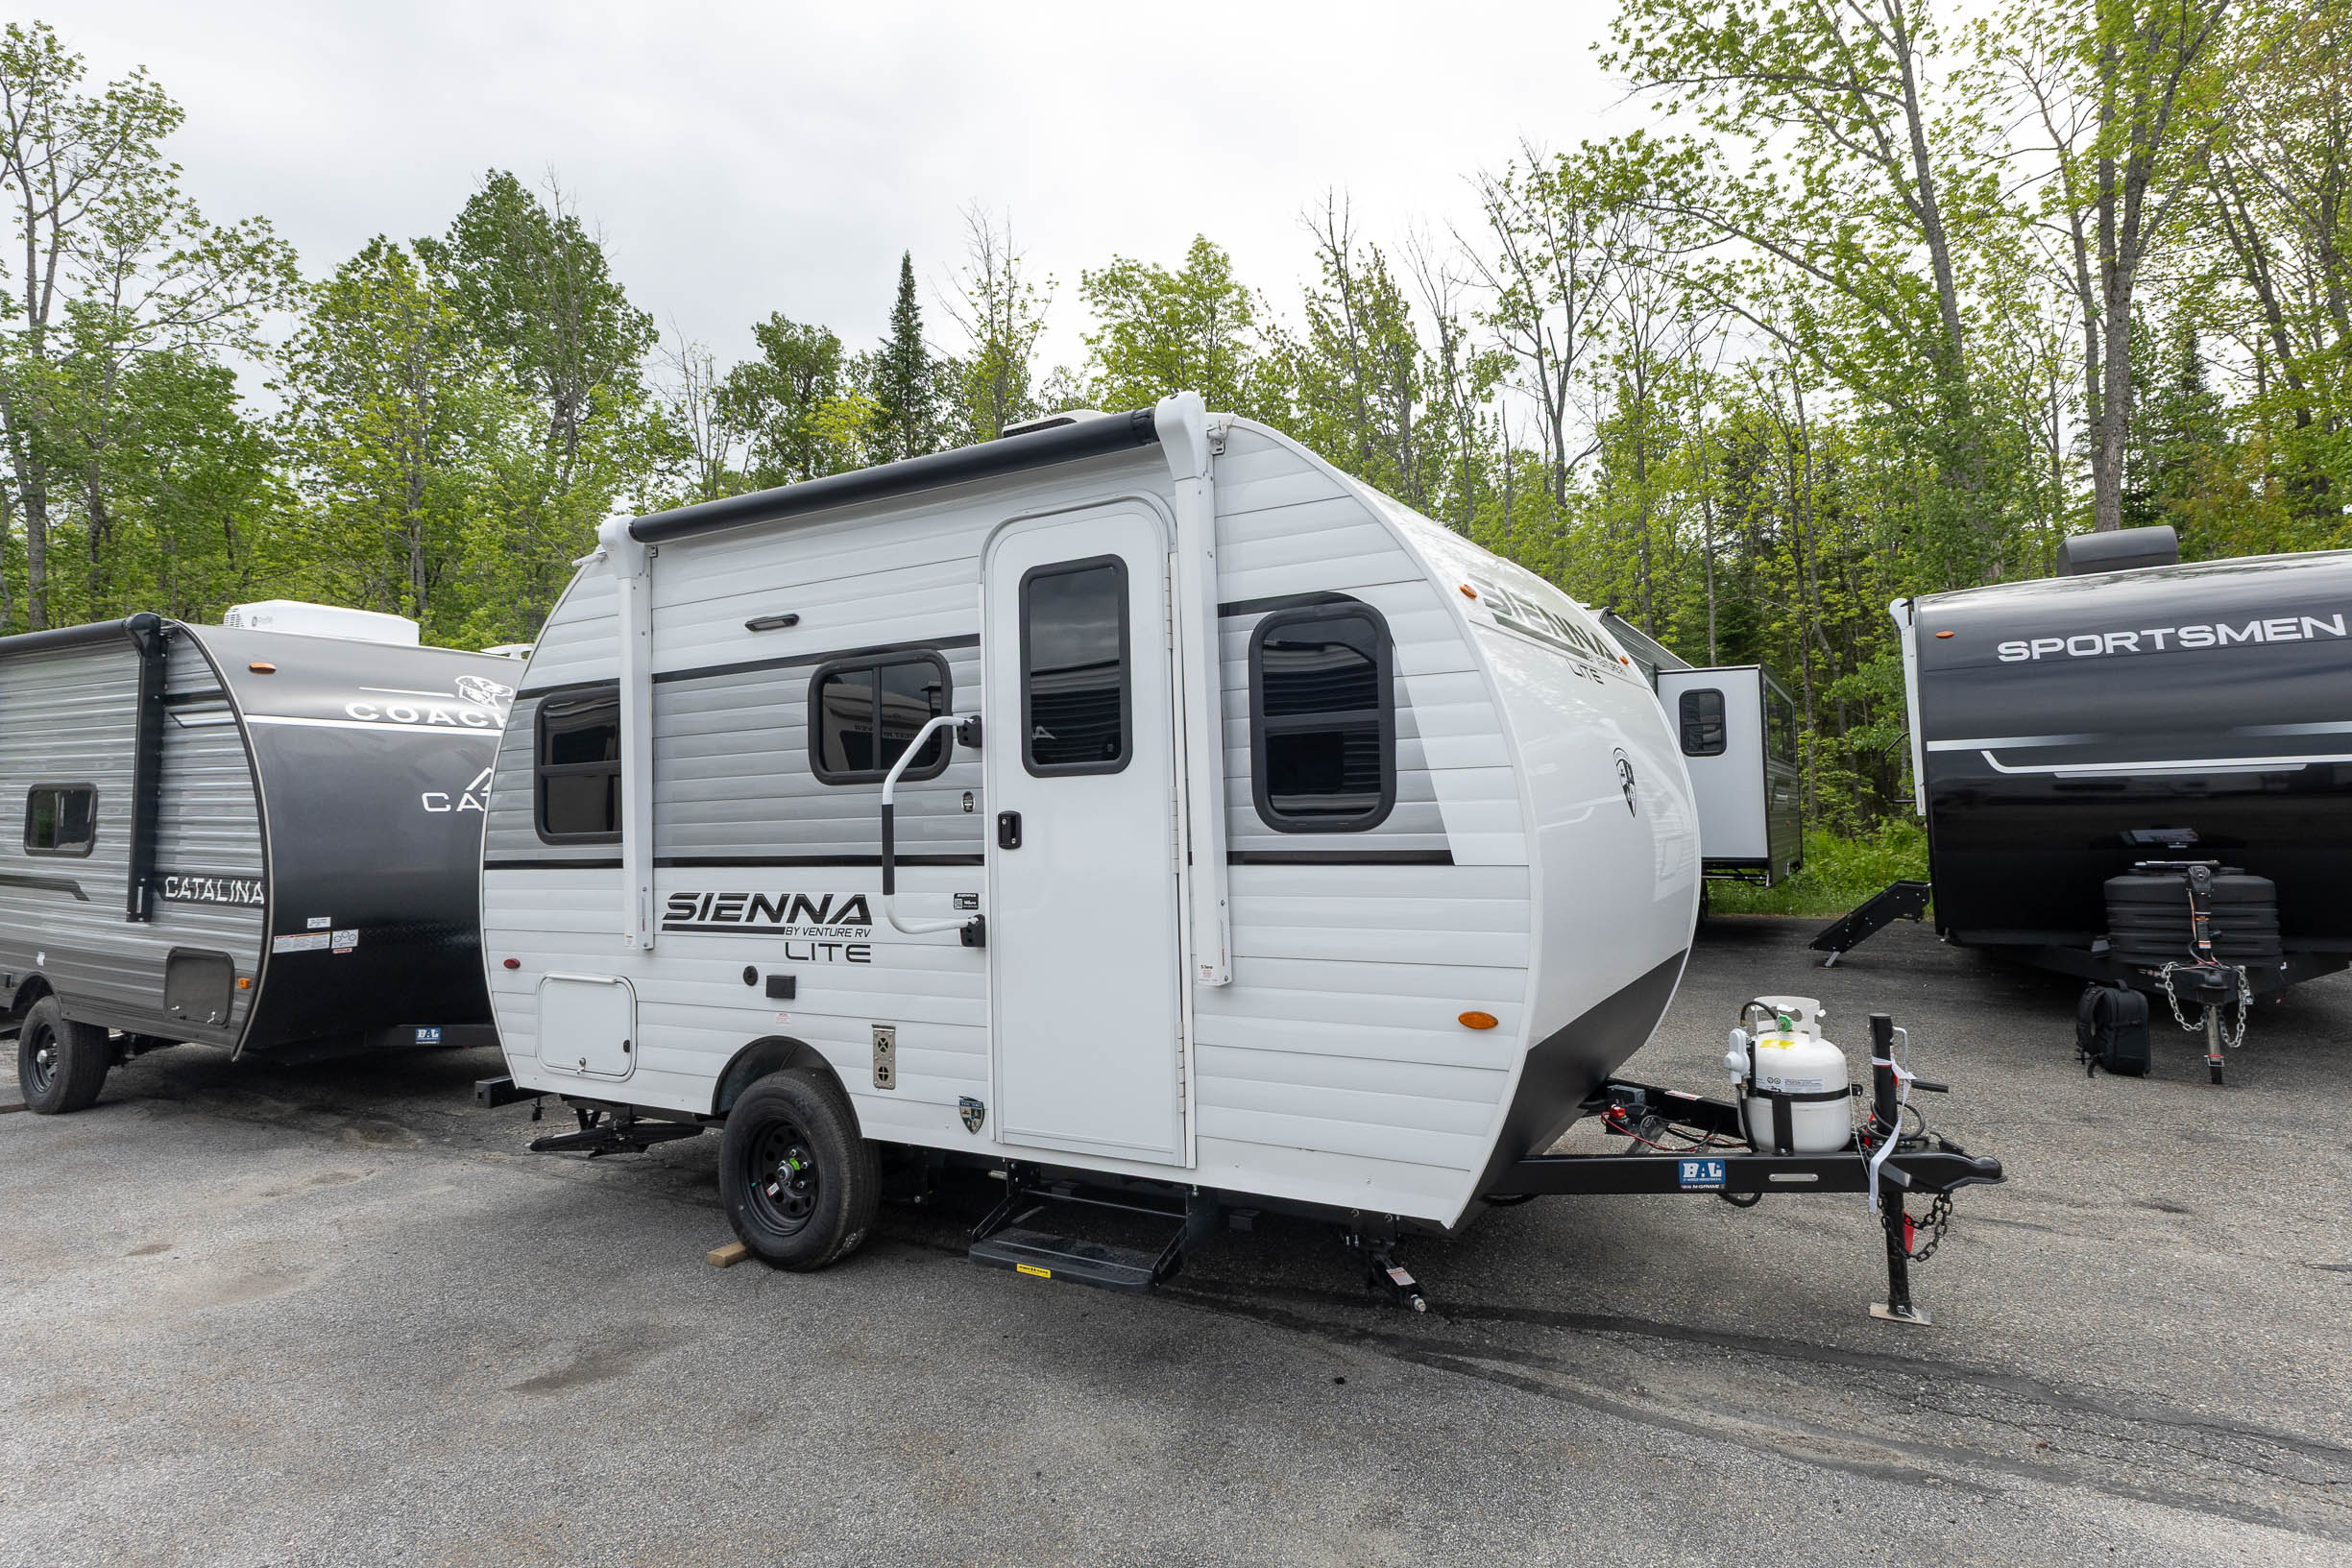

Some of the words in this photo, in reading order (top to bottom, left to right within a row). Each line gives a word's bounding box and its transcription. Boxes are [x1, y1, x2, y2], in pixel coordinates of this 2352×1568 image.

[1467, 572, 1620, 663] SIENNA
[1997, 614, 2347, 663] SPORTSMEN
[1565, 659, 1605, 685] LITE
[165, 876, 265, 905] CATALINA
[663, 892, 873, 926] SIENNA
[786, 927, 800, 936] BY
[803, 927, 853, 937] VENTURE
[855, 929, 871, 938] RV
[786, 941, 871, 963] LITE
[1683, 1162, 1722, 1177] BAL
